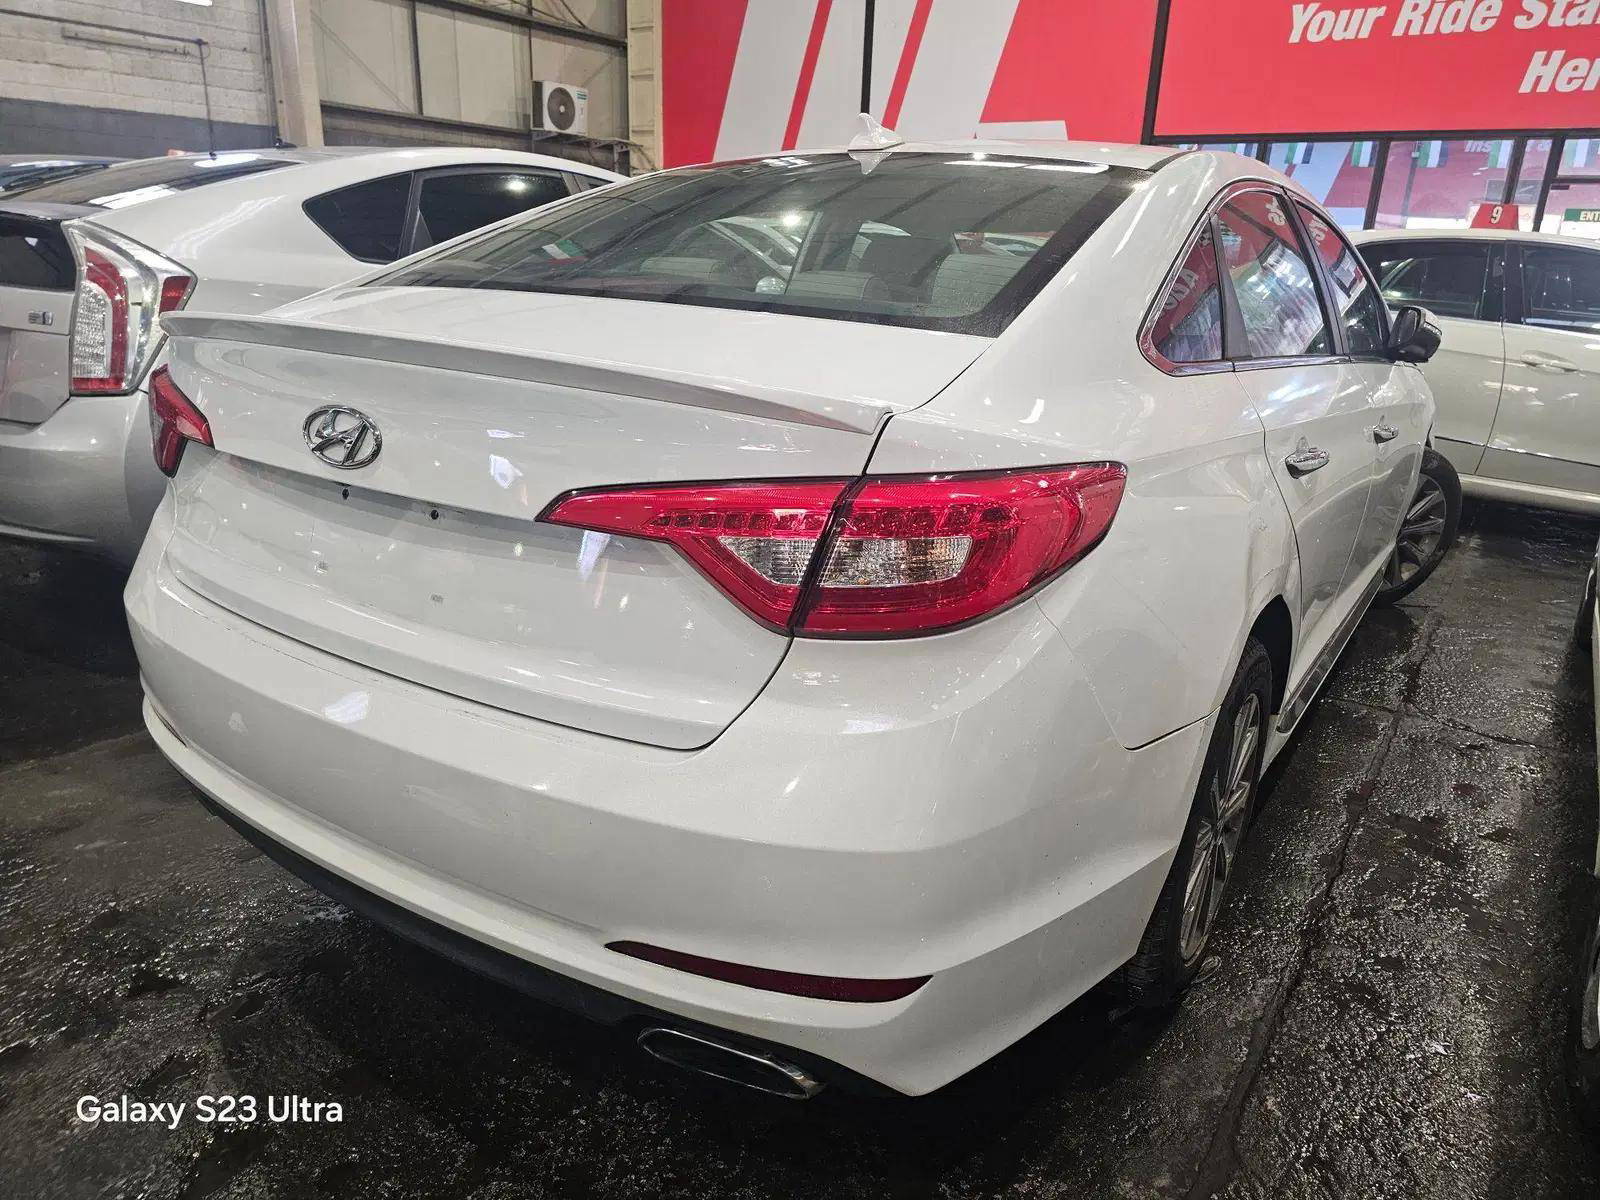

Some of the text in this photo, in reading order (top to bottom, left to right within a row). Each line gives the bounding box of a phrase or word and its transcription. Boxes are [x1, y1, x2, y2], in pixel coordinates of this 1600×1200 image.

[1288, 0, 1600, 44] Your Ride Sta
[1489, 205, 1503, 224] 9
